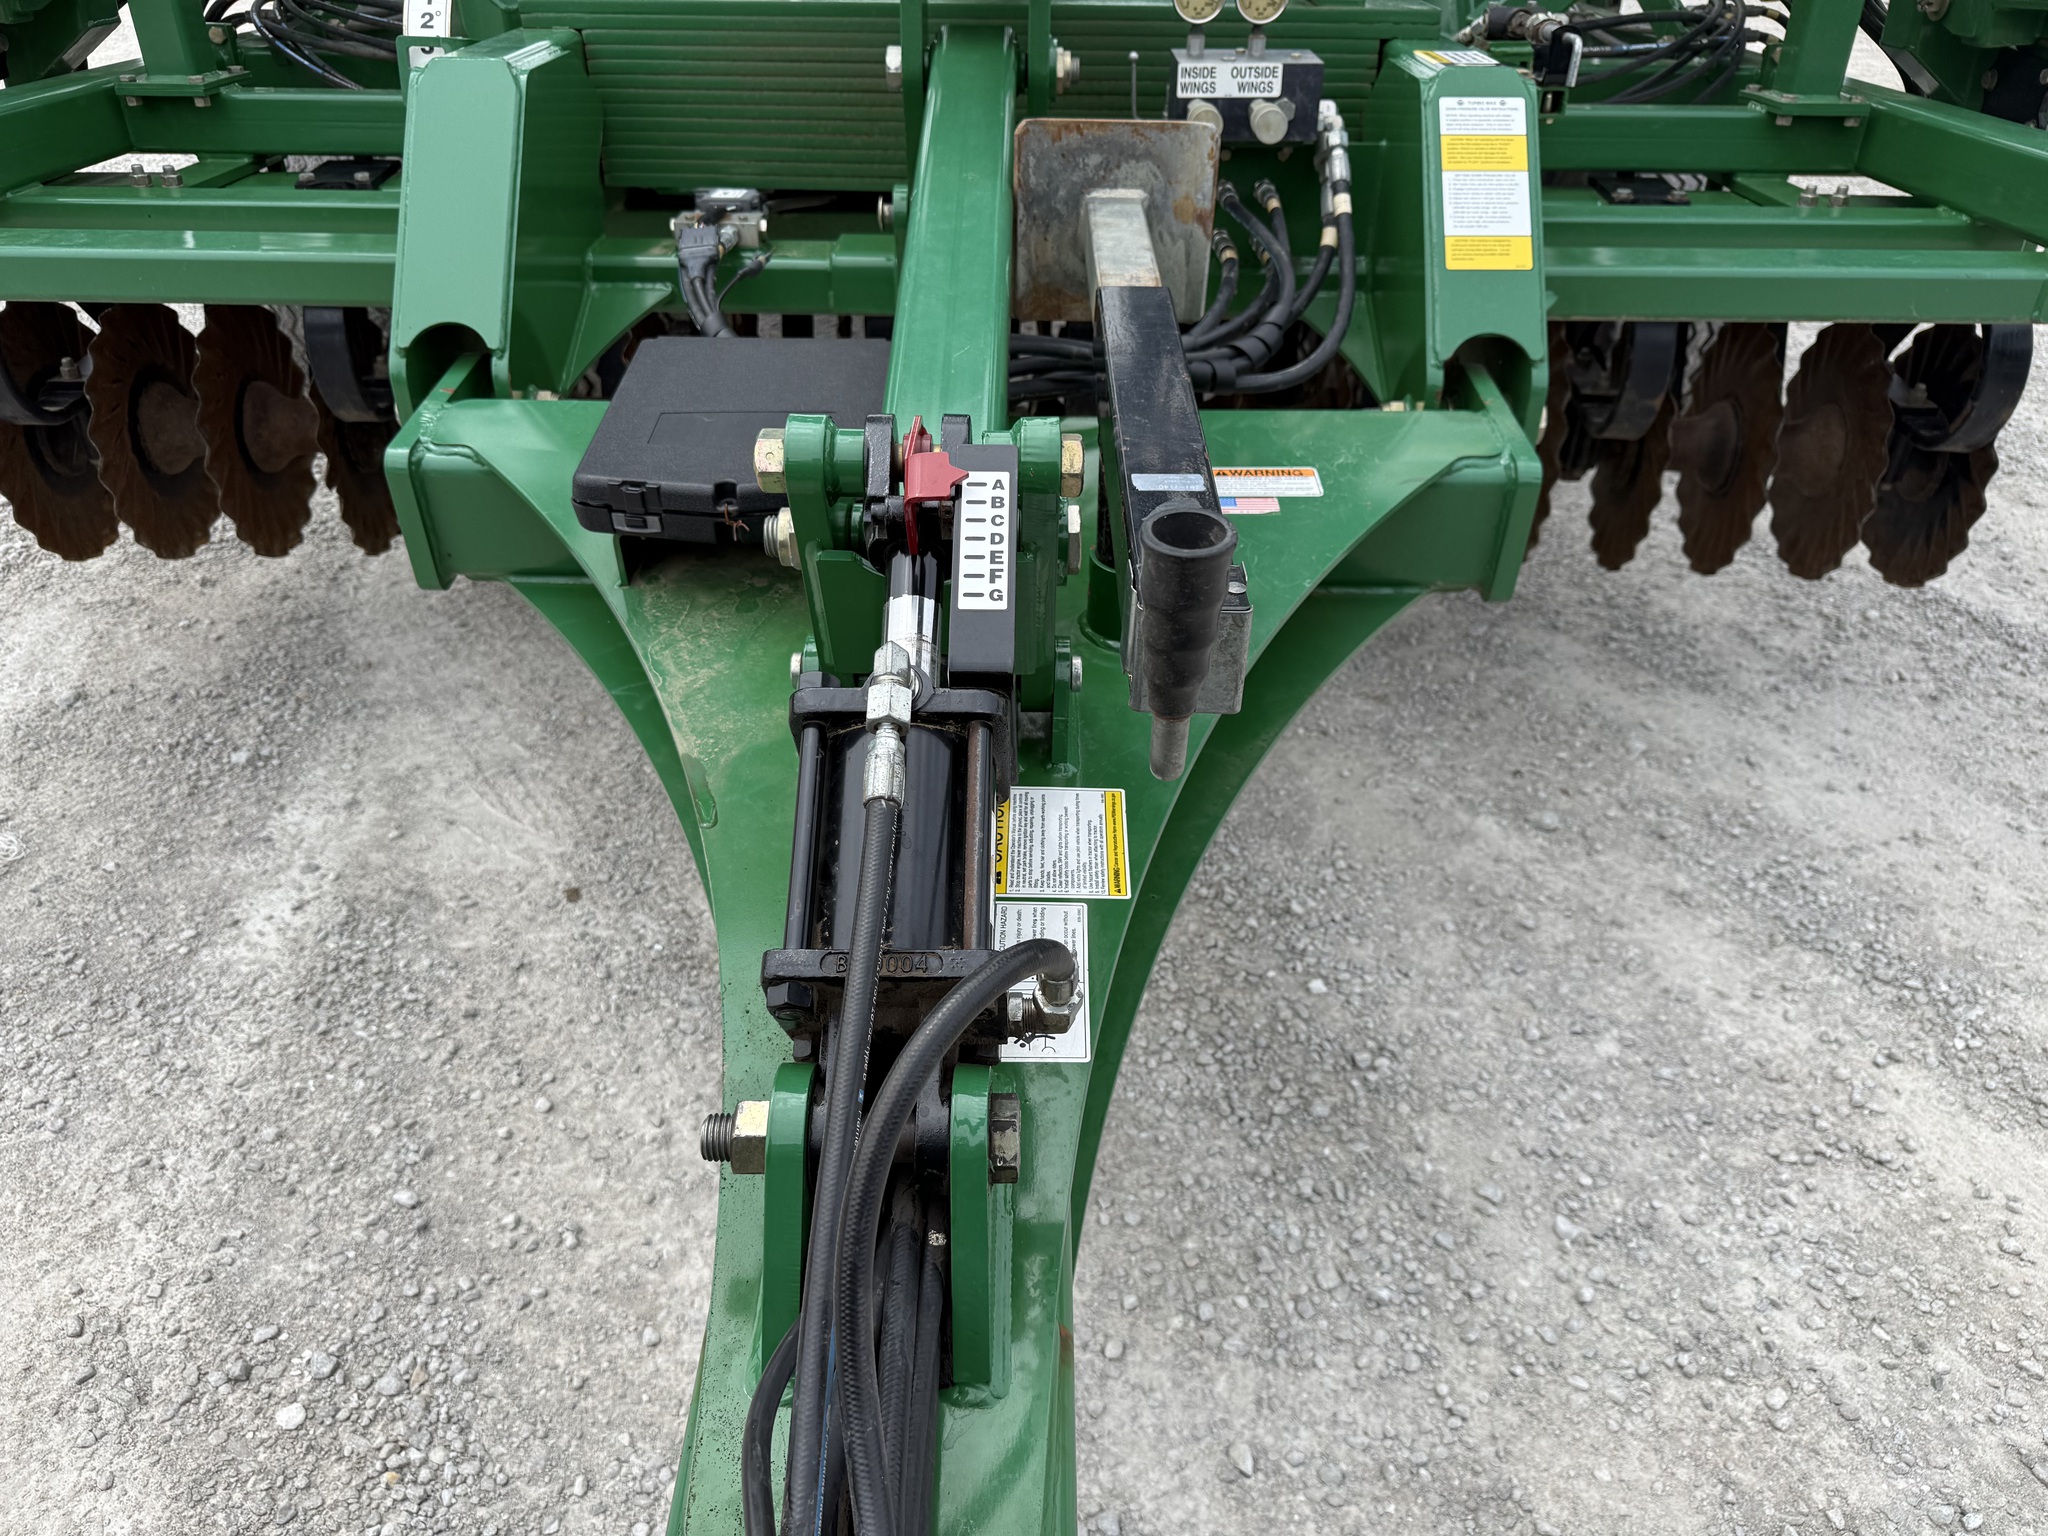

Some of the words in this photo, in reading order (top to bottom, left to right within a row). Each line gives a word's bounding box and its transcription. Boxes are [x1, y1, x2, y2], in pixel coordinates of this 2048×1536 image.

[1180, 66, 1217, 79] INSIDE
[1230, 66, 1279, 79] OUTSIDE
[1180, 82, 1216, 94] WINGS
[1238, 82, 1274, 94] WINGS
[992, 479, 1005, 490] A
[991, 496, 1005, 508] B
[991, 514, 1004, 526] C
[990, 533, 1004, 545] D
[990, 550, 1004, 564] E
[989, 569, 1004, 584] F
[989, 589, 1004, 602] G
[836, 956, 928, 972] B004
